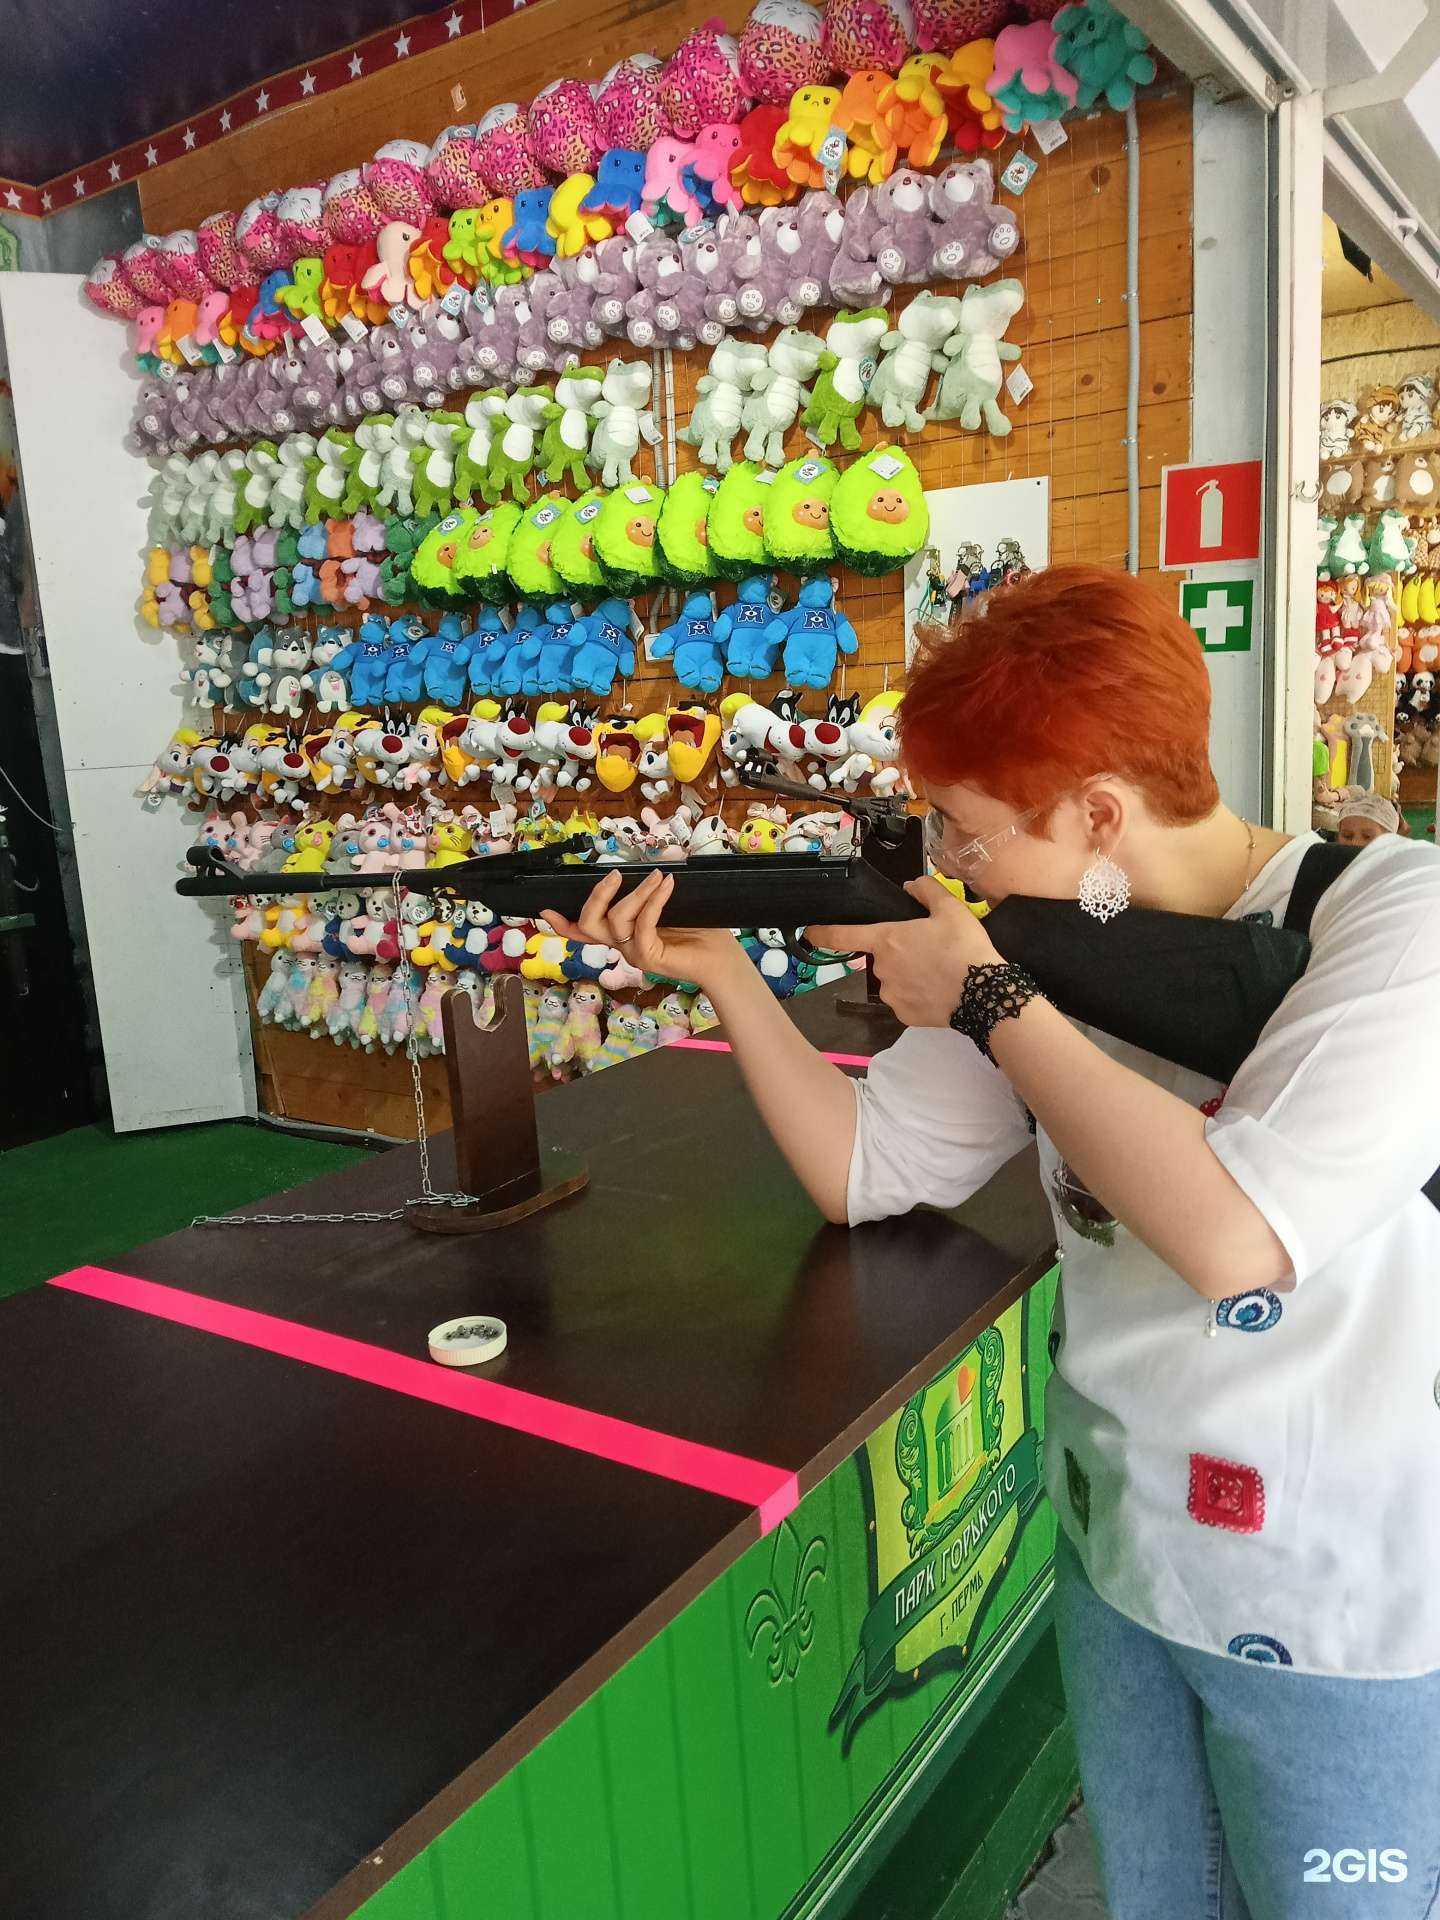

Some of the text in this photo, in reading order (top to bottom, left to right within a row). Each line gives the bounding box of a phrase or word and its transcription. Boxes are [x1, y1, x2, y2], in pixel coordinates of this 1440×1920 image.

[895, 1463, 1016, 1626] ПАРК ГОРЬКОГО
[951, 1571, 984, 1623] ПЕРМЬ
